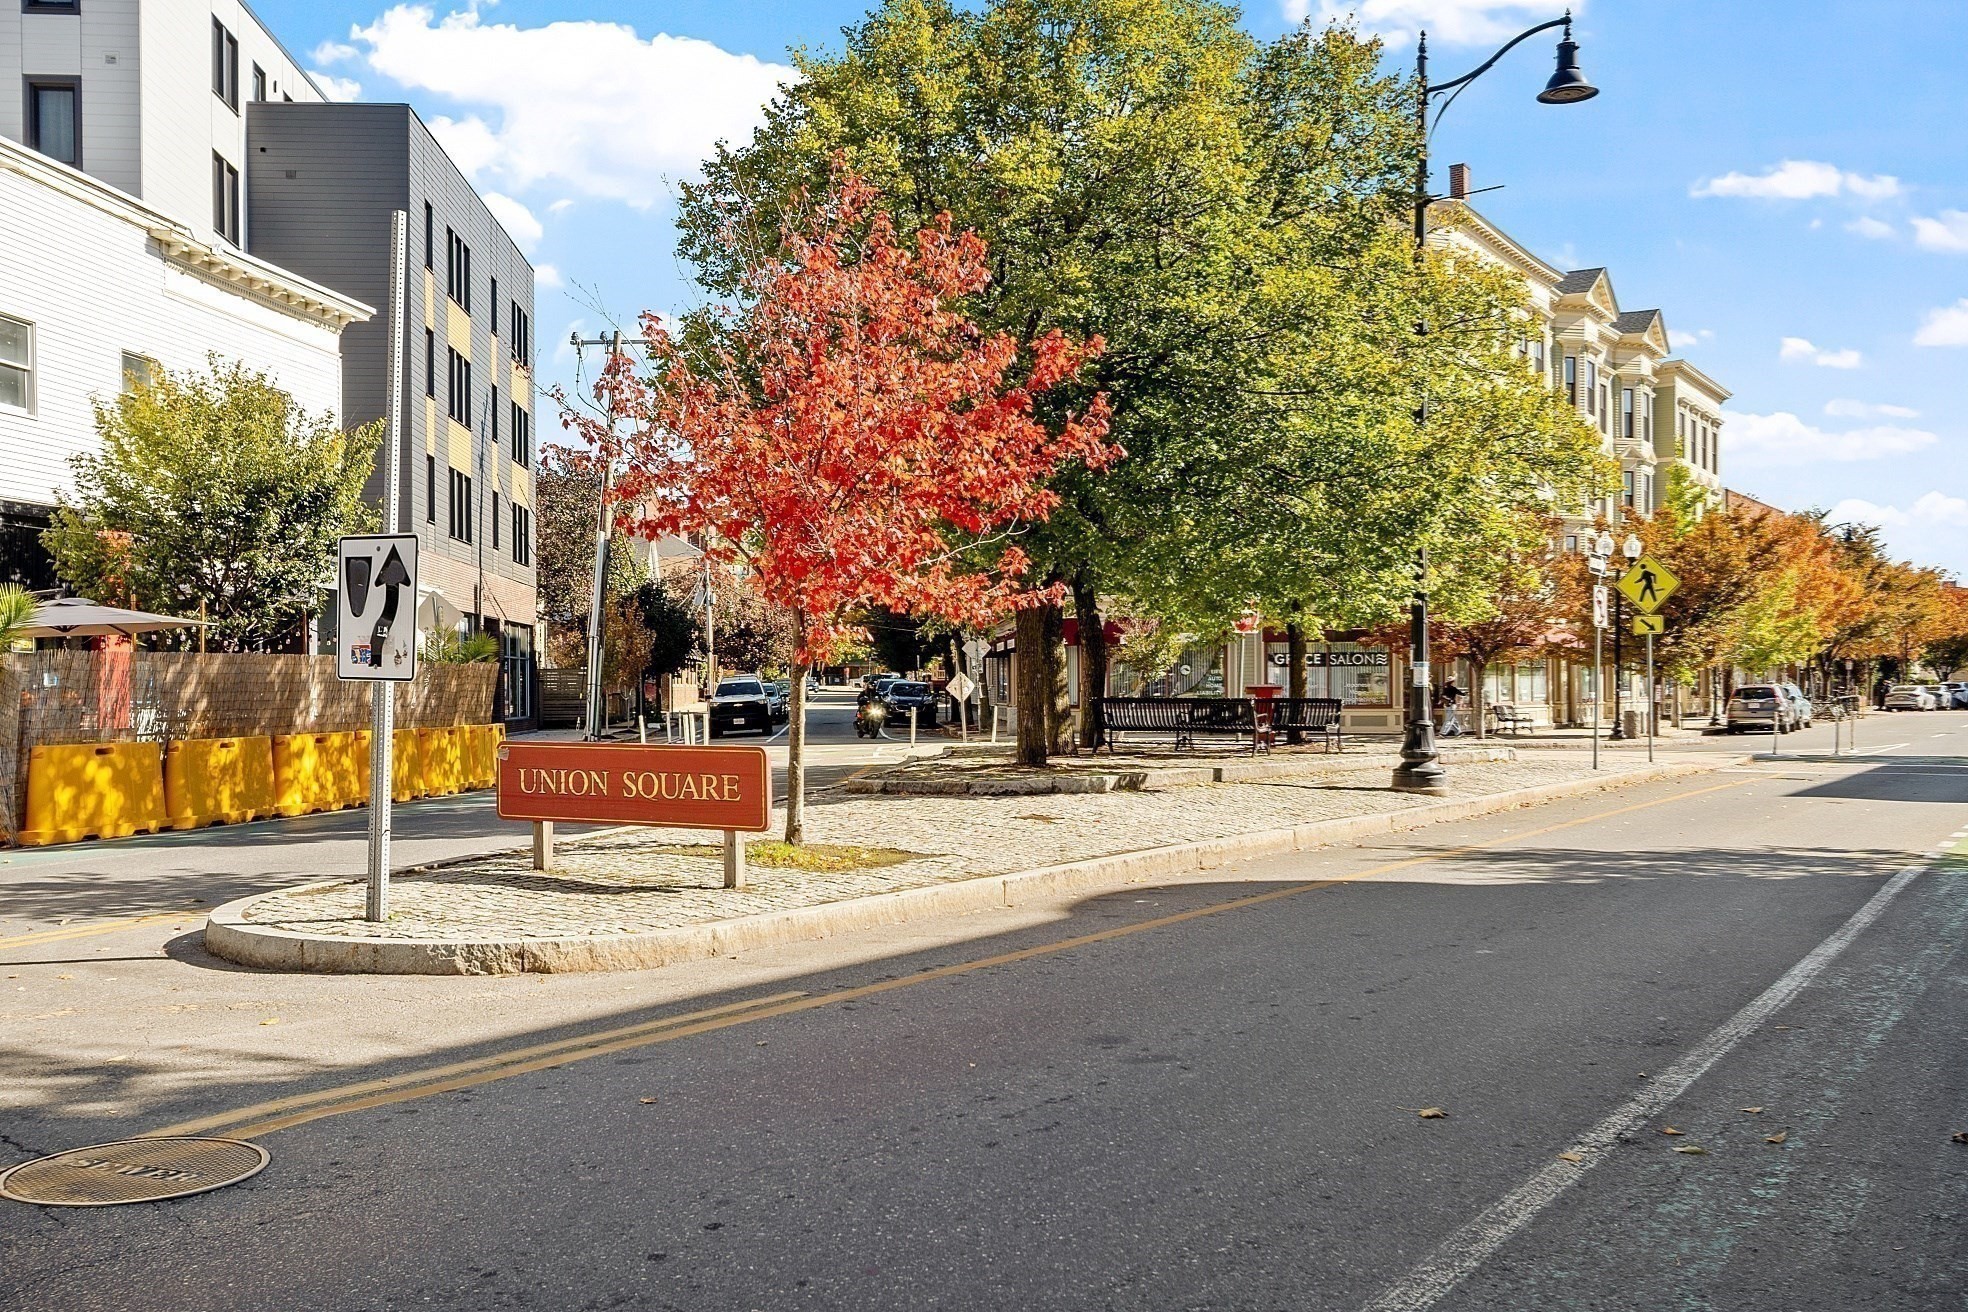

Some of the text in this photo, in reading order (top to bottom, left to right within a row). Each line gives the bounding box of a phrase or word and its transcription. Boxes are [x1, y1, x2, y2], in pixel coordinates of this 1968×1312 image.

[1274, 652, 1376, 665] GCE SALON
[518, 768, 742, 802] UNION SQUARE
[66, 1157, 203, 1182] SEWER
